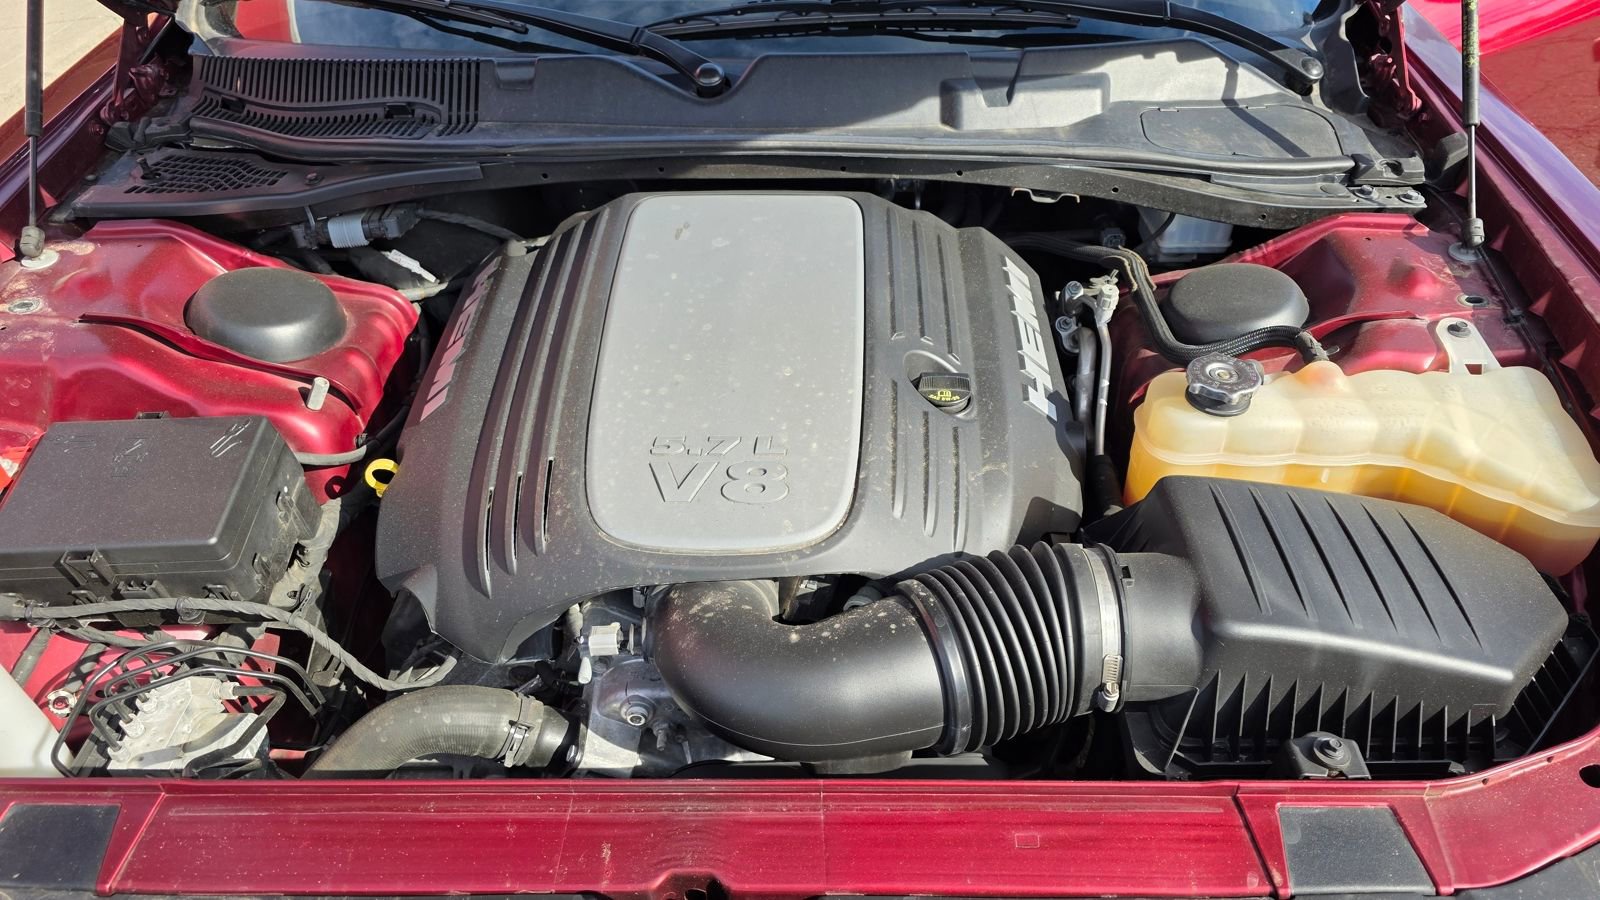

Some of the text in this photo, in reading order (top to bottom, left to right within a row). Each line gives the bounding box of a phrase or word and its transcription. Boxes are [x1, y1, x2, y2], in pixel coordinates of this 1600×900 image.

[419, 256, 502, 422] HEMI
[1002, 255, 1058, 422] HEMI
[648, 460, 790, 505] V8
[649, 433, 742, 456] 5.7
